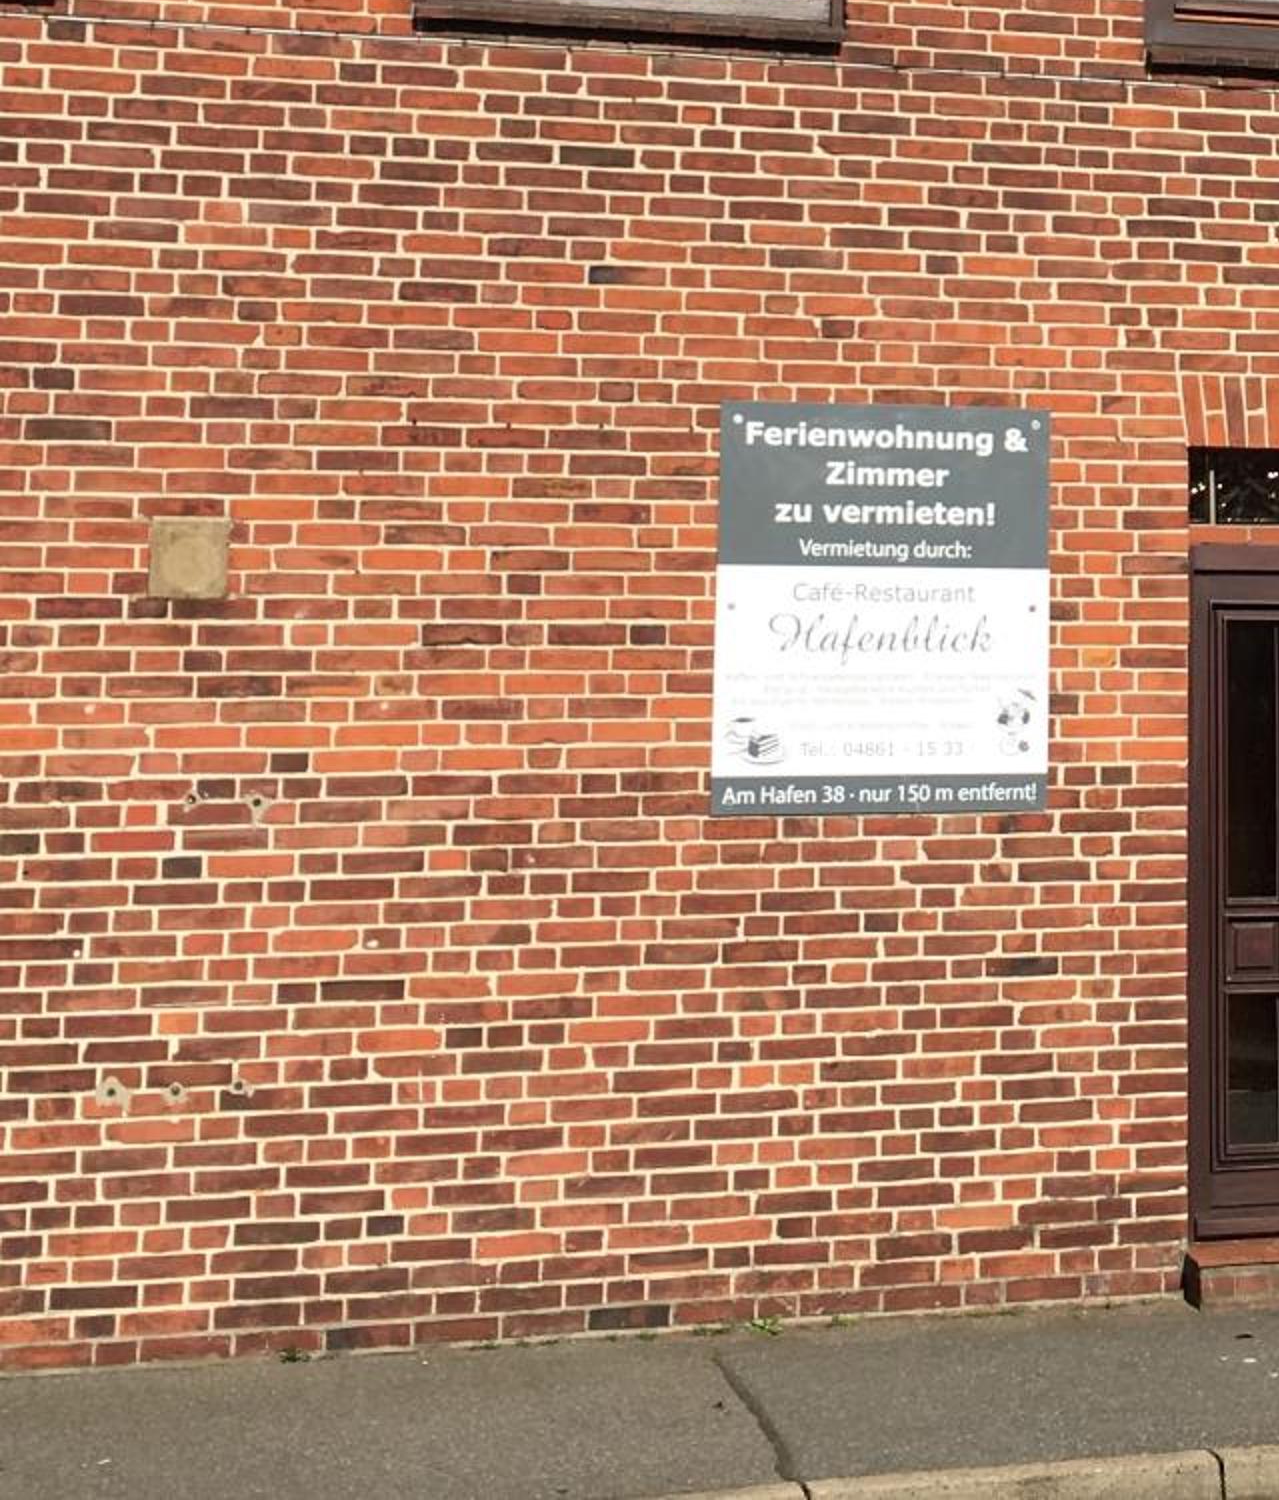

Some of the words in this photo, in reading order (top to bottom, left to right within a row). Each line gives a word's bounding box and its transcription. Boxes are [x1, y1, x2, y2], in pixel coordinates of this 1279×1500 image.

[744, 419, 994, 457] Ferienwohnung
[1003, 426, 1030, 453] &
[825, 459, 950, 488] Zimmer
[774, 502, 813, 524] zu
[822, 500, 997, 527] vermieten!
[799, 537, 910, 563] Vermietung
[912, 539, 974, 560] durch:
[792, 581, 977, 605] Café-Restaurant
[767, 612, 993, 667] Hafenblick
[721, 786, 756, 805] Am
[760, 784, 817, 805] Hafen
[821, 784, 847, 804] 38
[858, 788, 893, 804] nur
[897, 783, 932, 803] 150
[934, 787, 955, 802] m
[957, 781, 1038, 802] entfernt!
